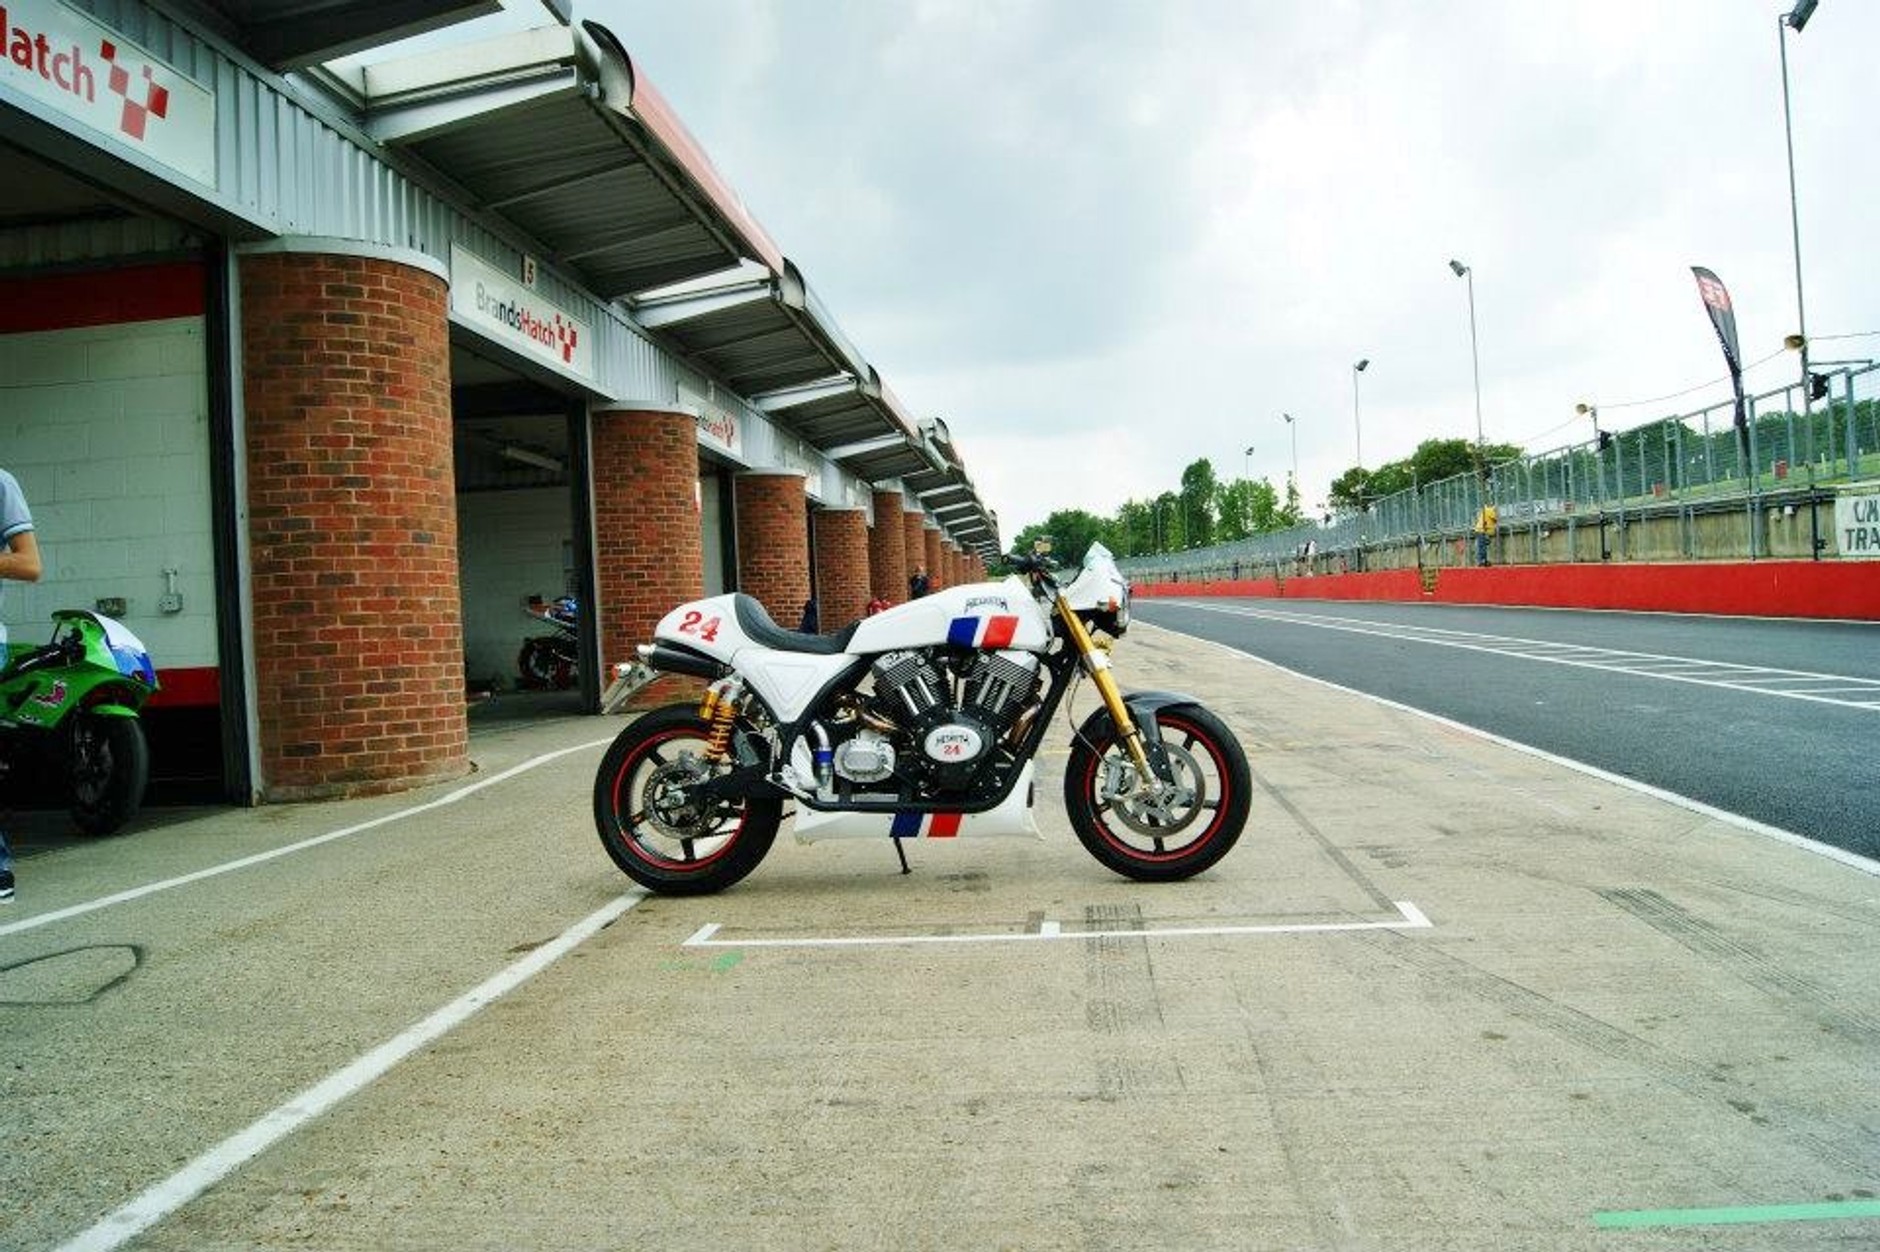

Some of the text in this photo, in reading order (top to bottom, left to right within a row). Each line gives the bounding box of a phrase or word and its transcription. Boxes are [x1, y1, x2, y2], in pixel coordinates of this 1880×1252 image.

[476, 282, 555, 349] BrandsHatch
[679, 611, 721, 642] 24
[944, 744, 960, 755] 24
